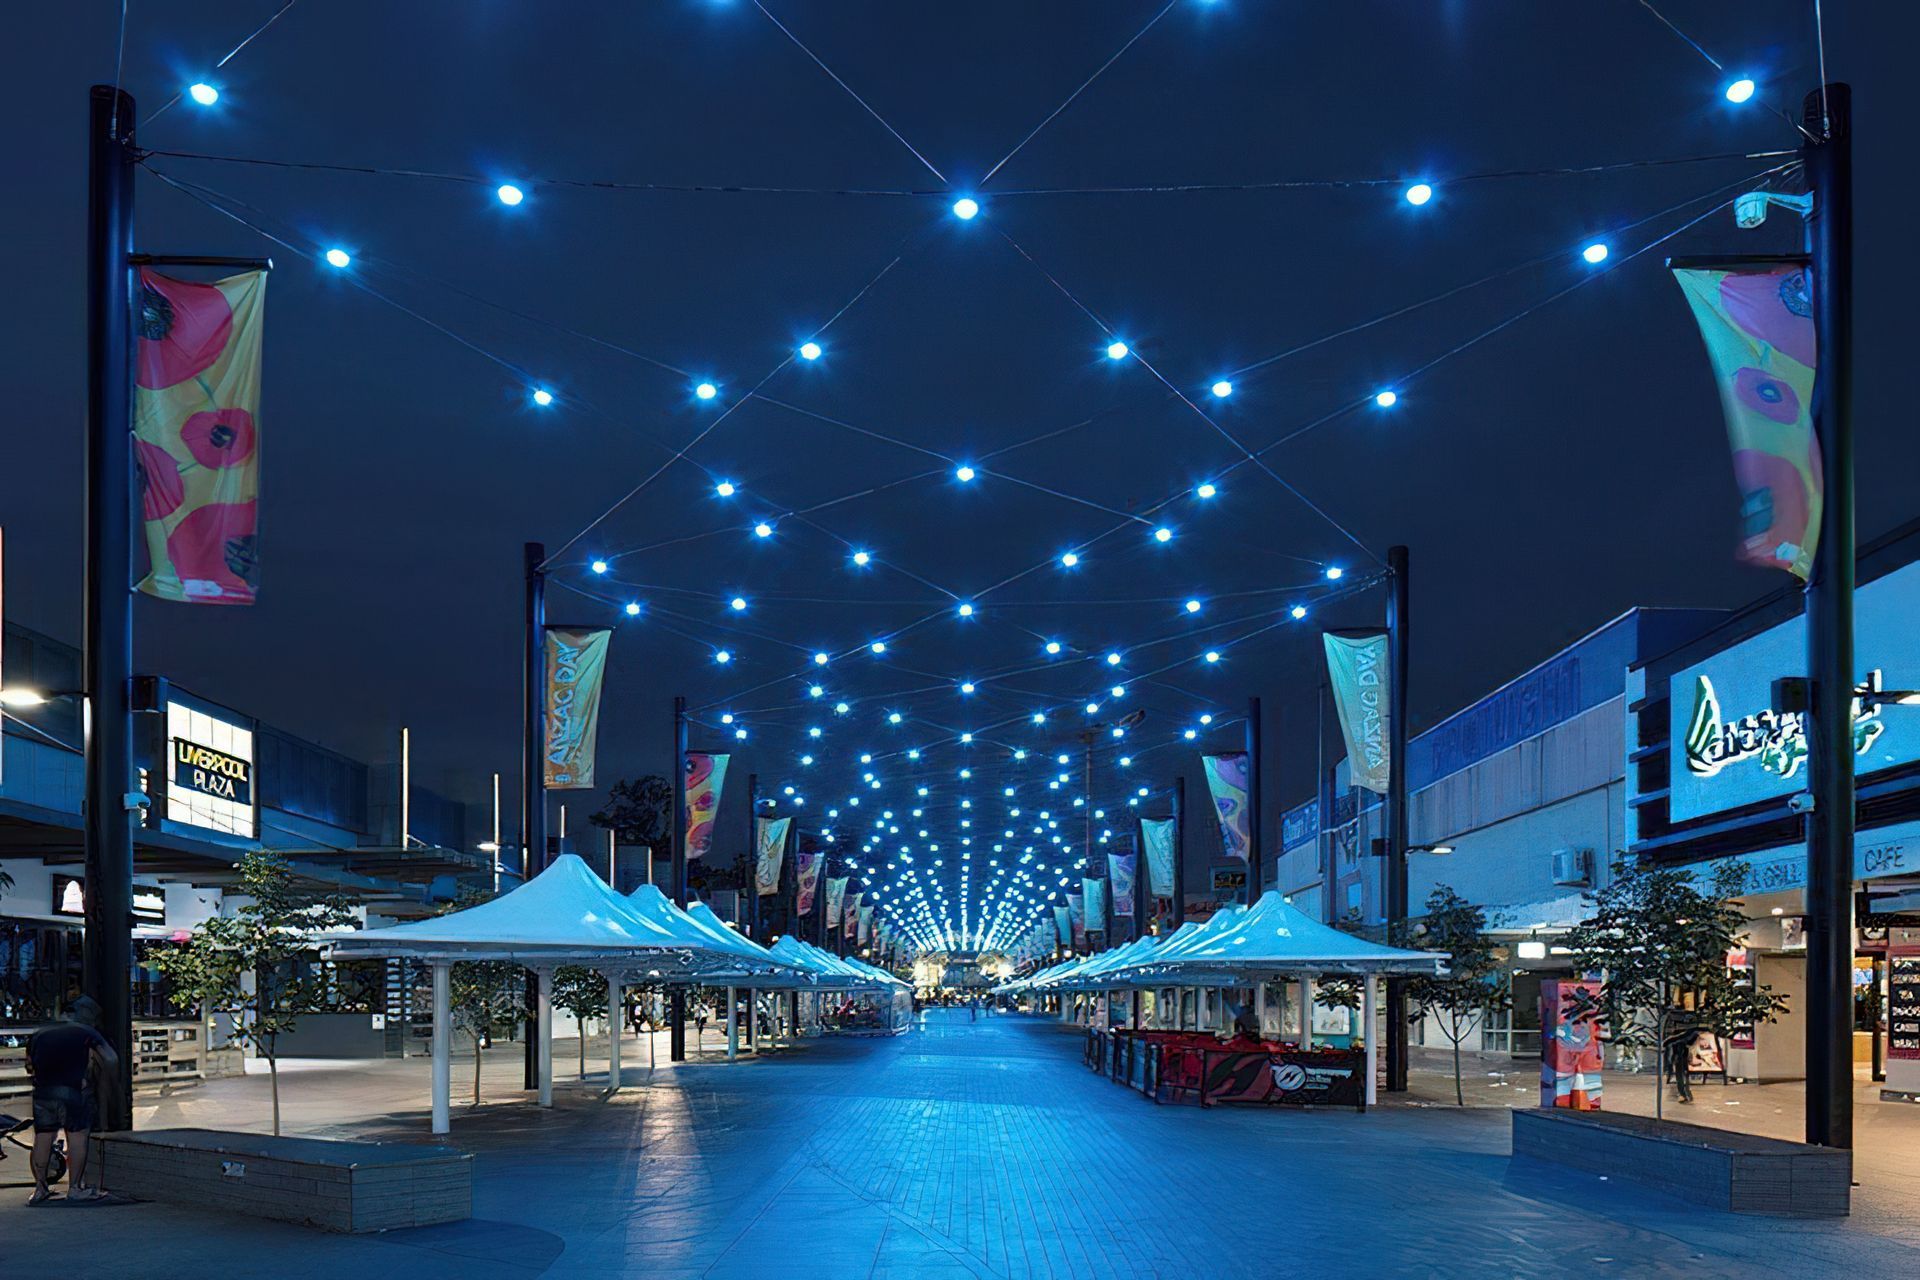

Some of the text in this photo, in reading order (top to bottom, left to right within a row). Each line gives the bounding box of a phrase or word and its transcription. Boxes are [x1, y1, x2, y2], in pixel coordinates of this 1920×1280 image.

[547, 641, 578, 766] ANZAC DAY
[194, 769, 235, 798] PLAZA
